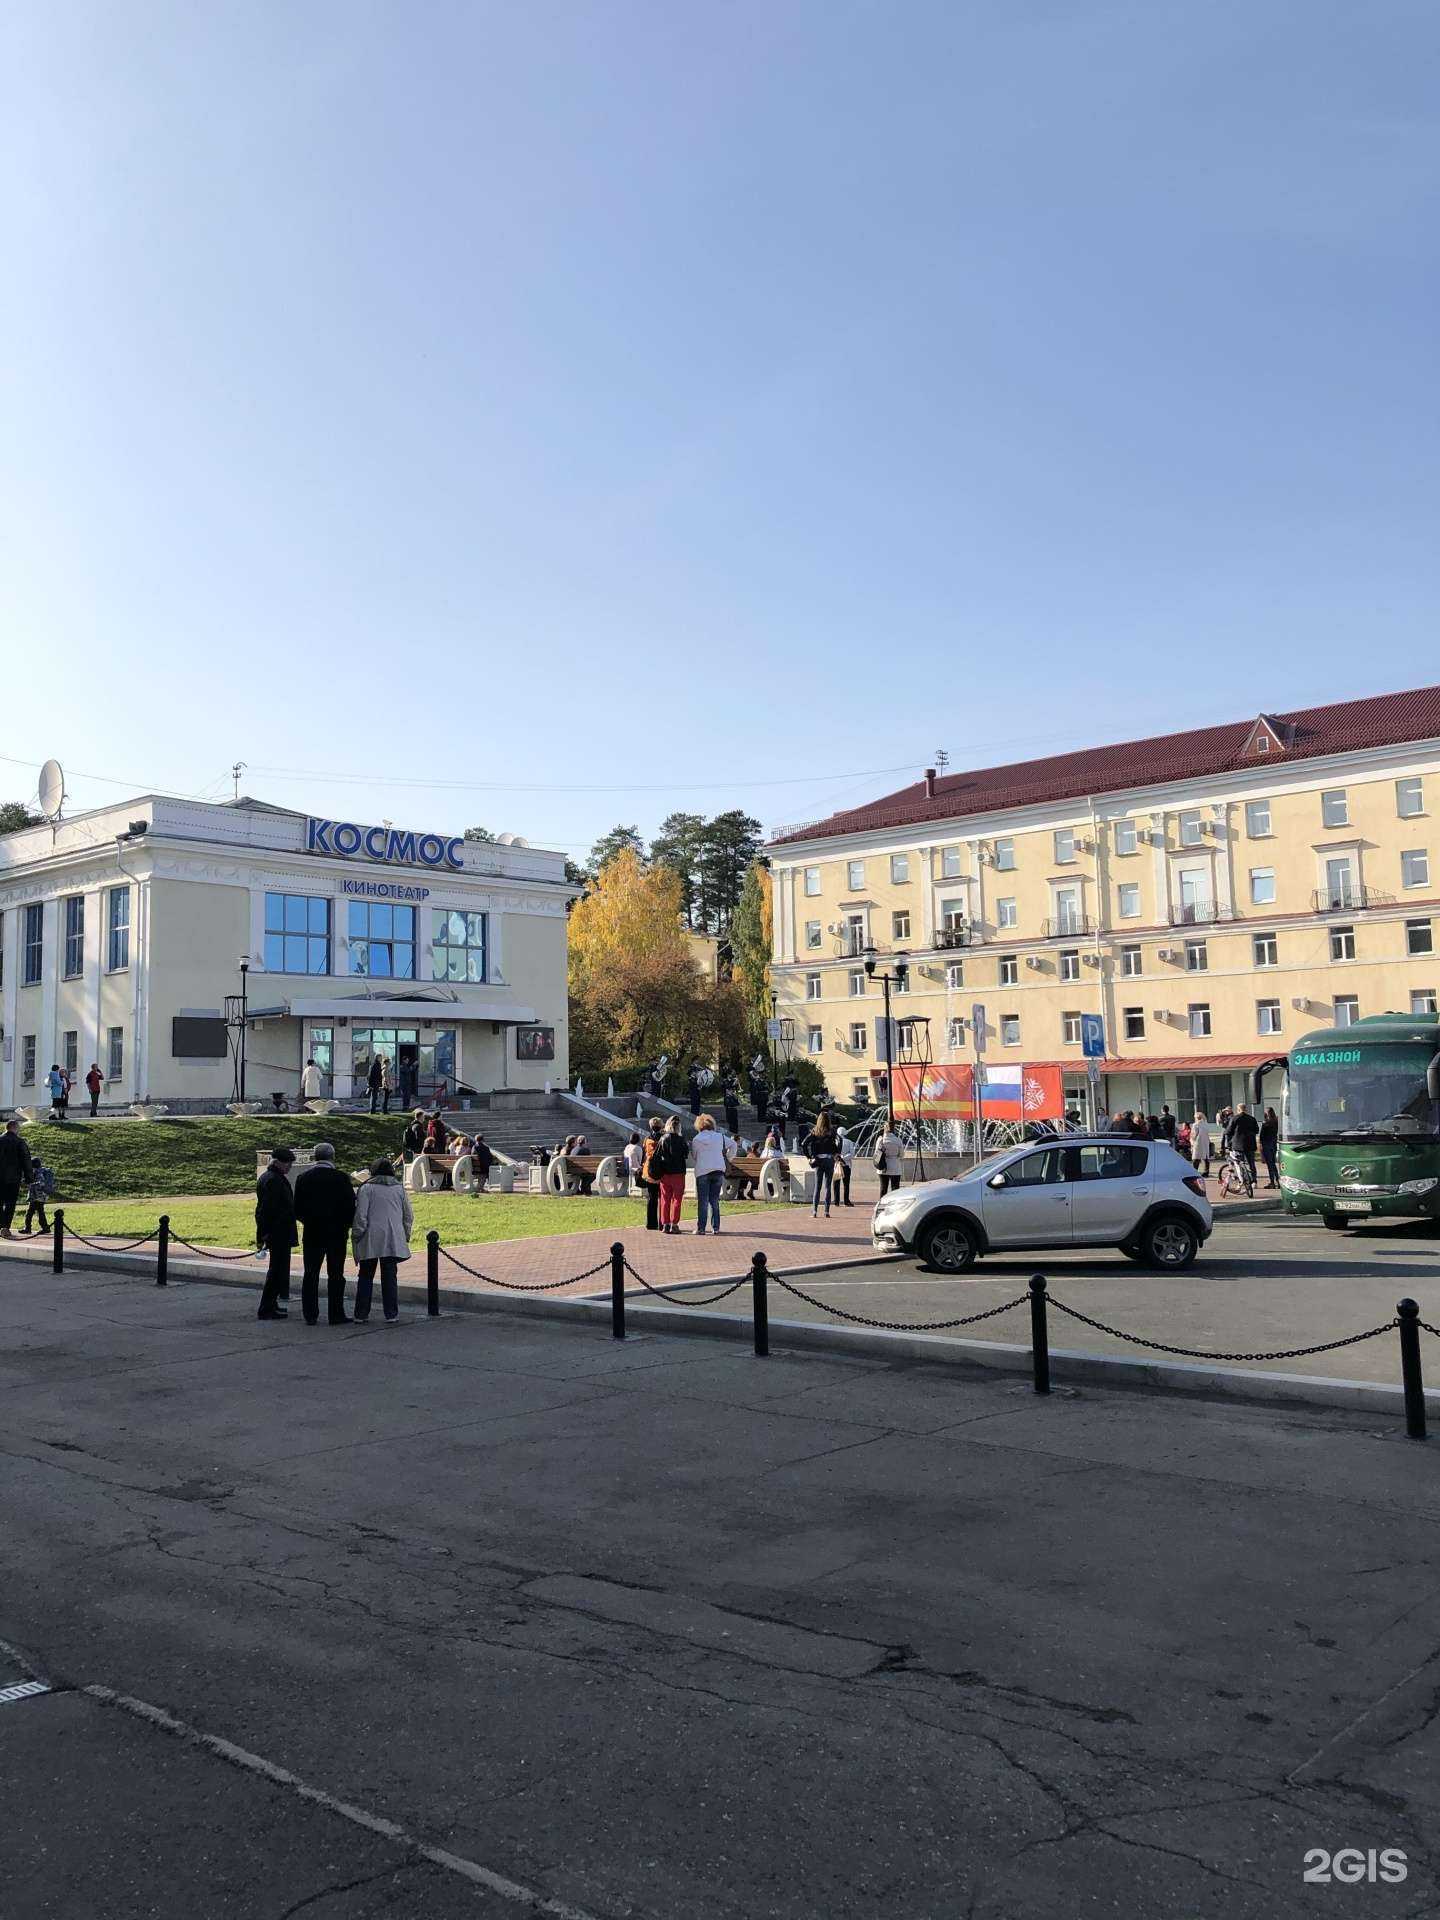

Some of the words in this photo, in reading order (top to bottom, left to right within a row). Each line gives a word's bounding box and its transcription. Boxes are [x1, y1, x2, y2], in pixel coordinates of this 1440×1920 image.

[307, 817, 465, 868] КОСМОС
[344, 879, 430, 901] КИНОТЕАТР
[1295, 1050, 1360, 1065] ЗАКАЗНОЙ
